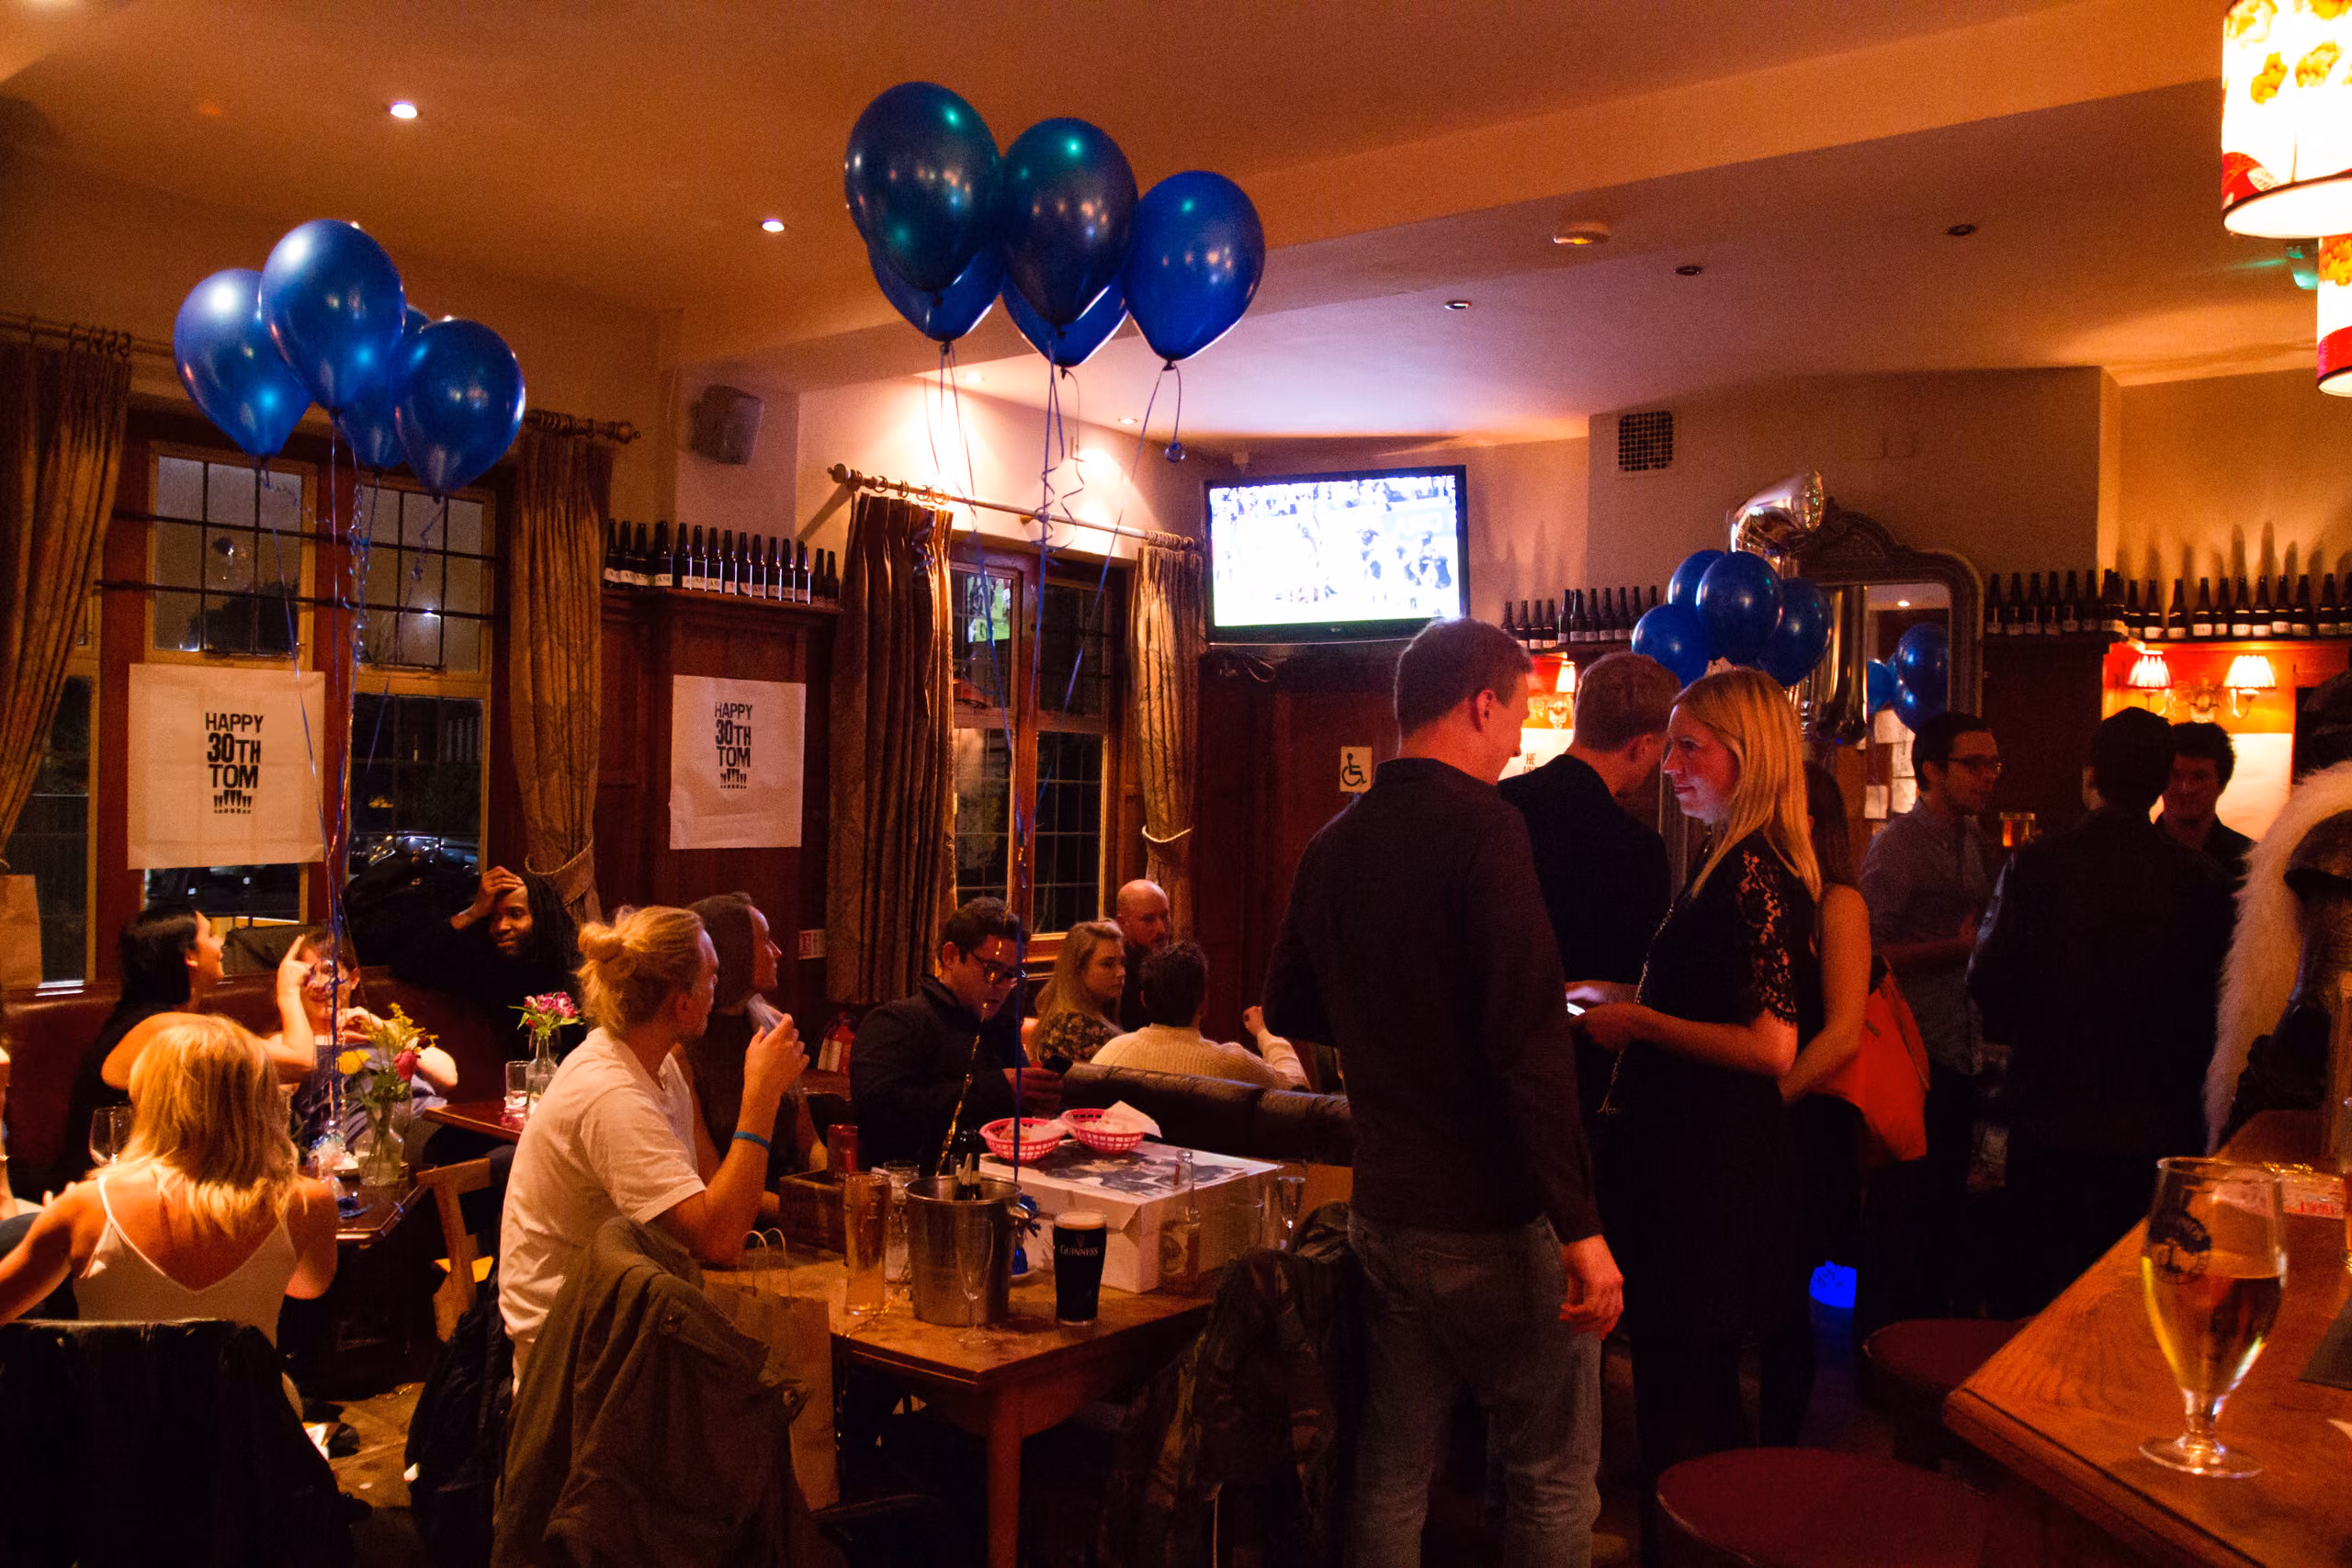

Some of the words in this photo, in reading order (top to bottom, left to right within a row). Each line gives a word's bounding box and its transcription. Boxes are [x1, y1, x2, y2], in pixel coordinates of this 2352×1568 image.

[715, 702, 752, 720] HAPPY
[206, 713, 265, 733] HAPPY
[716, 719, 751, 746] 30TH
[207, 732, 261, 763] 30TH
[717, 746, 751, 767] TOM
[208, 763, 259, 789] TOM
[1059, 1244, 1099, 1258] GUINNESS
